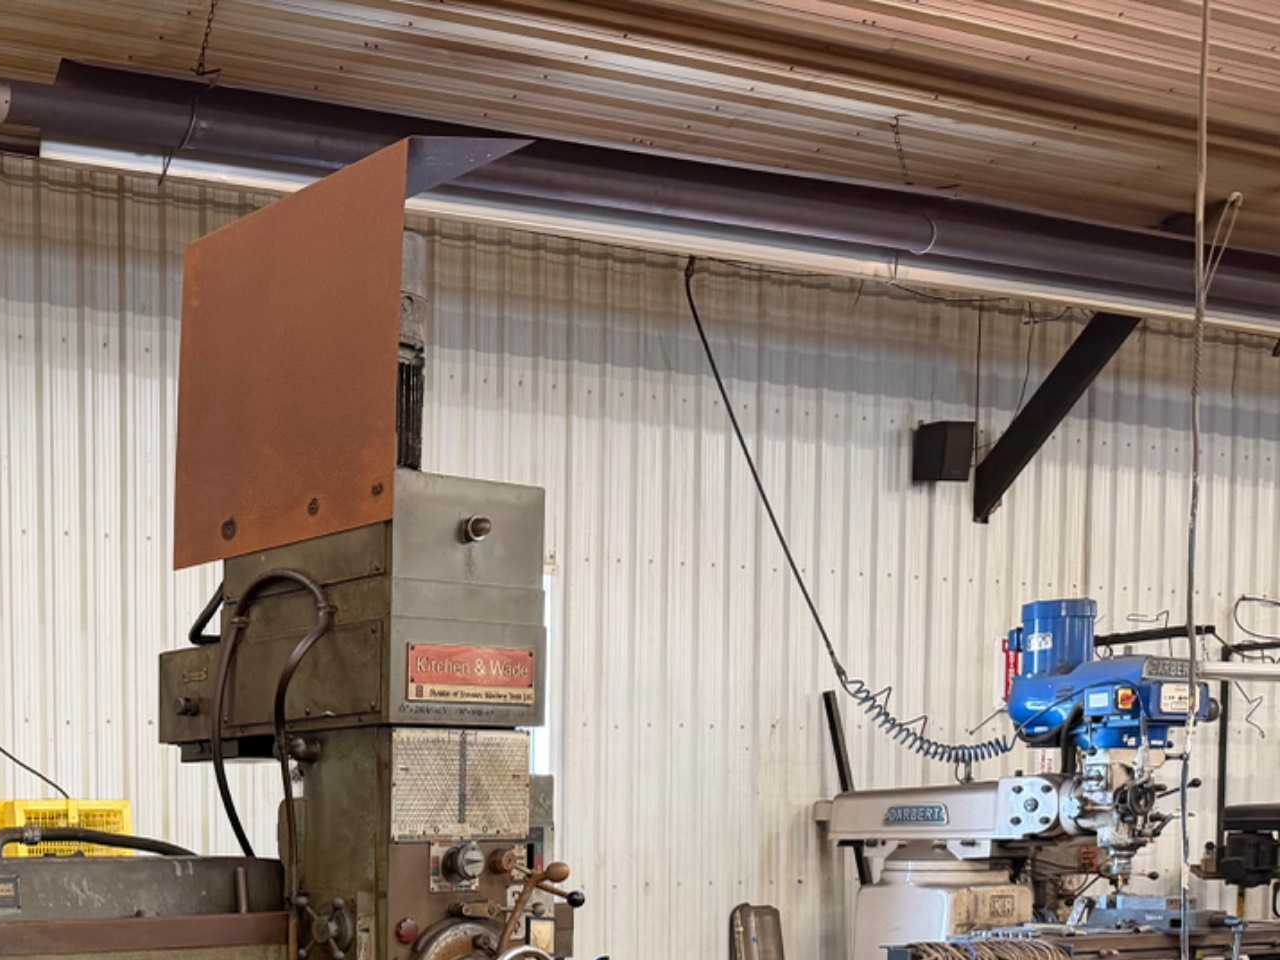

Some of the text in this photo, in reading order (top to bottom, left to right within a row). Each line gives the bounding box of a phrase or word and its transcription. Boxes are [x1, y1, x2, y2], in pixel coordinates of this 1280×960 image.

[417, 656, 529, 677] Kitchen & Wade
